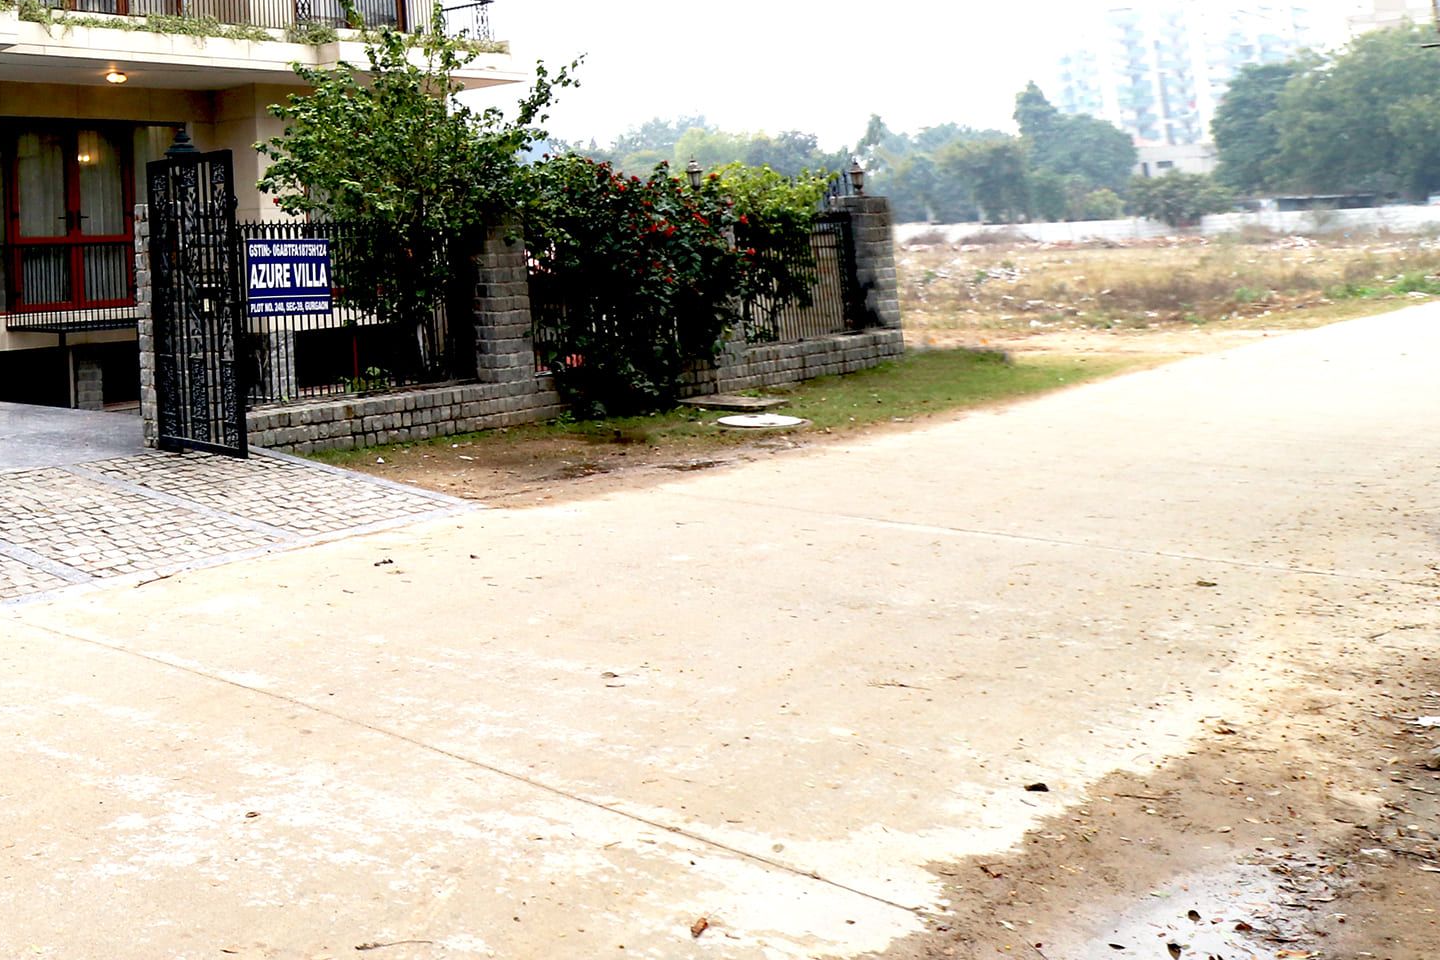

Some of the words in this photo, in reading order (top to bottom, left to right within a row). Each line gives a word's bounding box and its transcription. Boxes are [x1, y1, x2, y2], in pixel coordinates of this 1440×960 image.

[250, 263, 291, 289] AZURE
[293, 263, 328, 287] VILLA
[250, 303, 264, 313] PLOT
[264, 302, 274, 312] NO.
[305, 301, 329, 311] GURGAON
